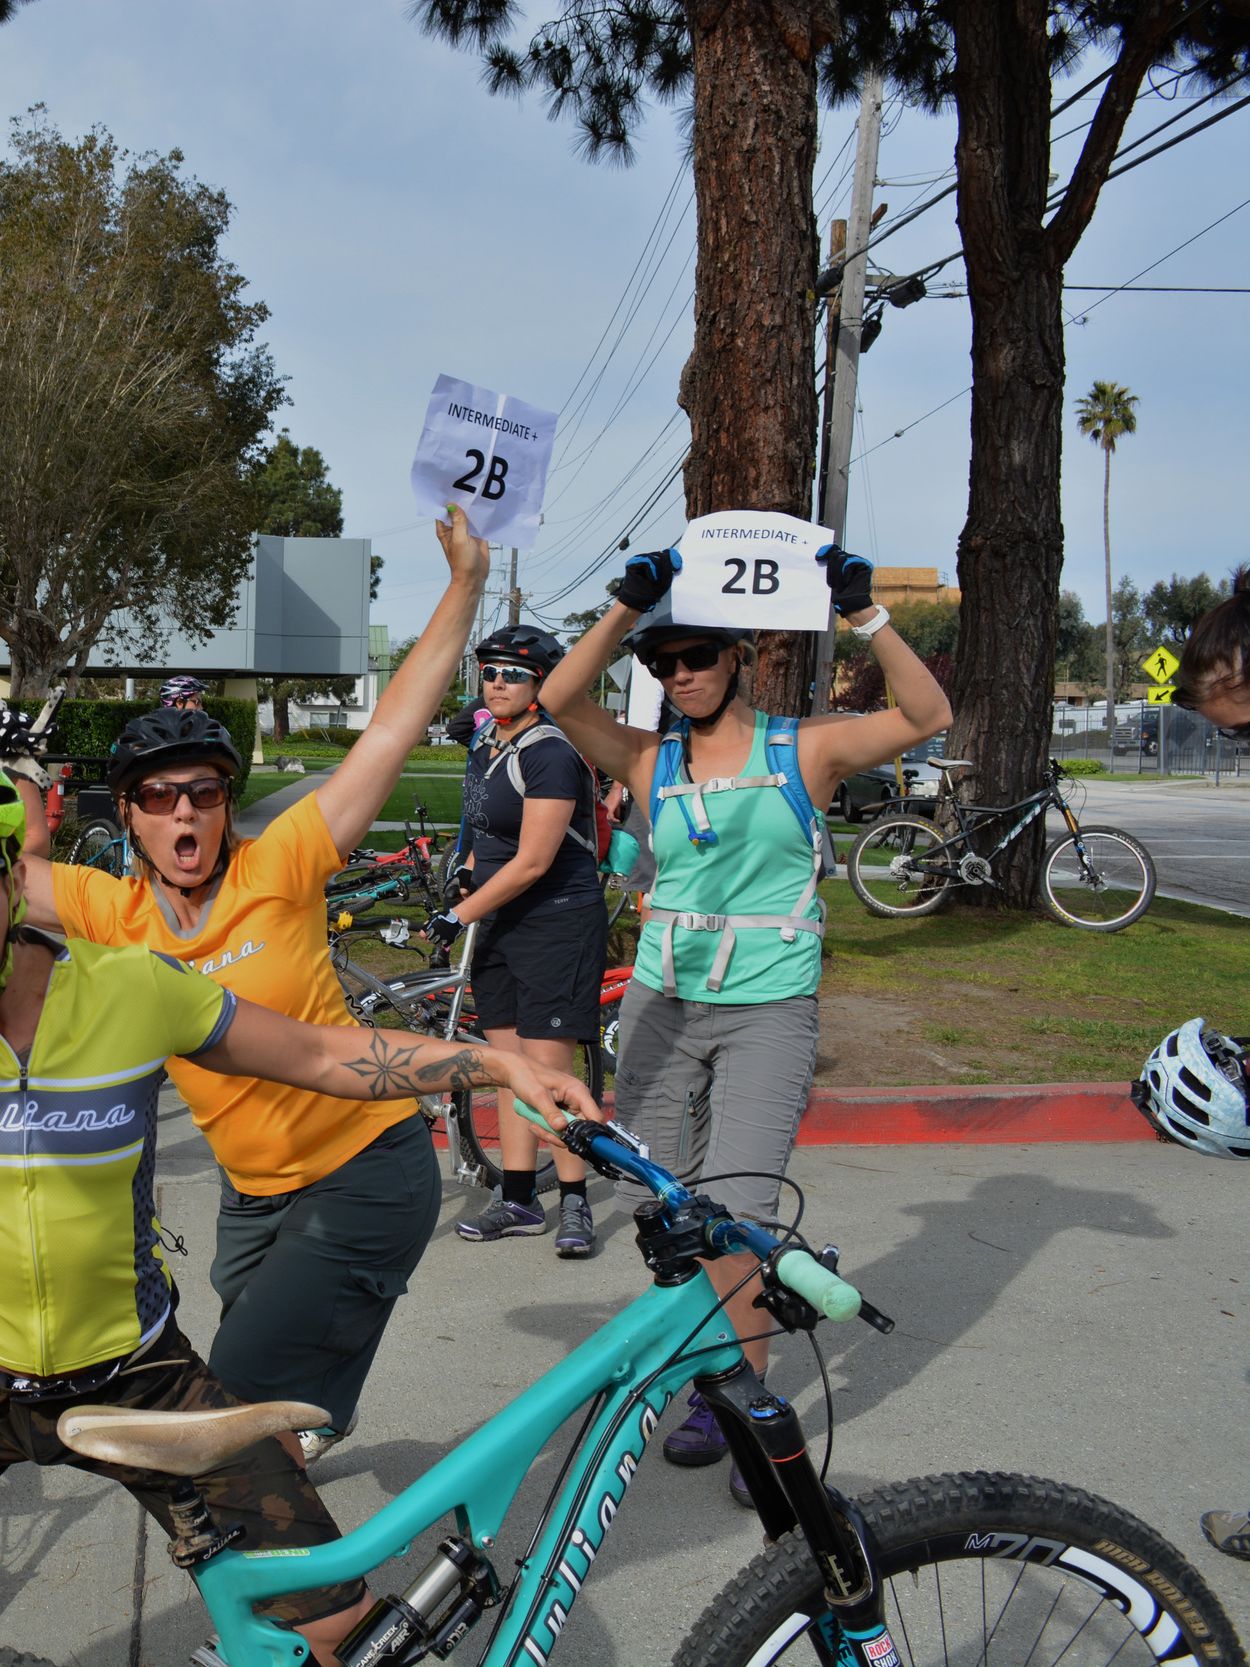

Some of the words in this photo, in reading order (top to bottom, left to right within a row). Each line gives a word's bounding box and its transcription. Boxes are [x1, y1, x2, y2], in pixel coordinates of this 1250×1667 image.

[448, 403, 530, 440] INTERMEDIATE
[452, 449, 509, 500] 2B
[702, 528, 798, 544] INTERMEDIATE
[722, 558, 780, 595] 2B
[998, 804, 1041, 849] YETI
[1092, 1539, 1150, 1573] HIGH
[1142, 1569, 1211, 1637] ROLLER
[375, 1624, 398, 1650] CREEK
[868, 1637, 892, 1657] ROCK
[874, 1649, 898, 1667] SHOX
